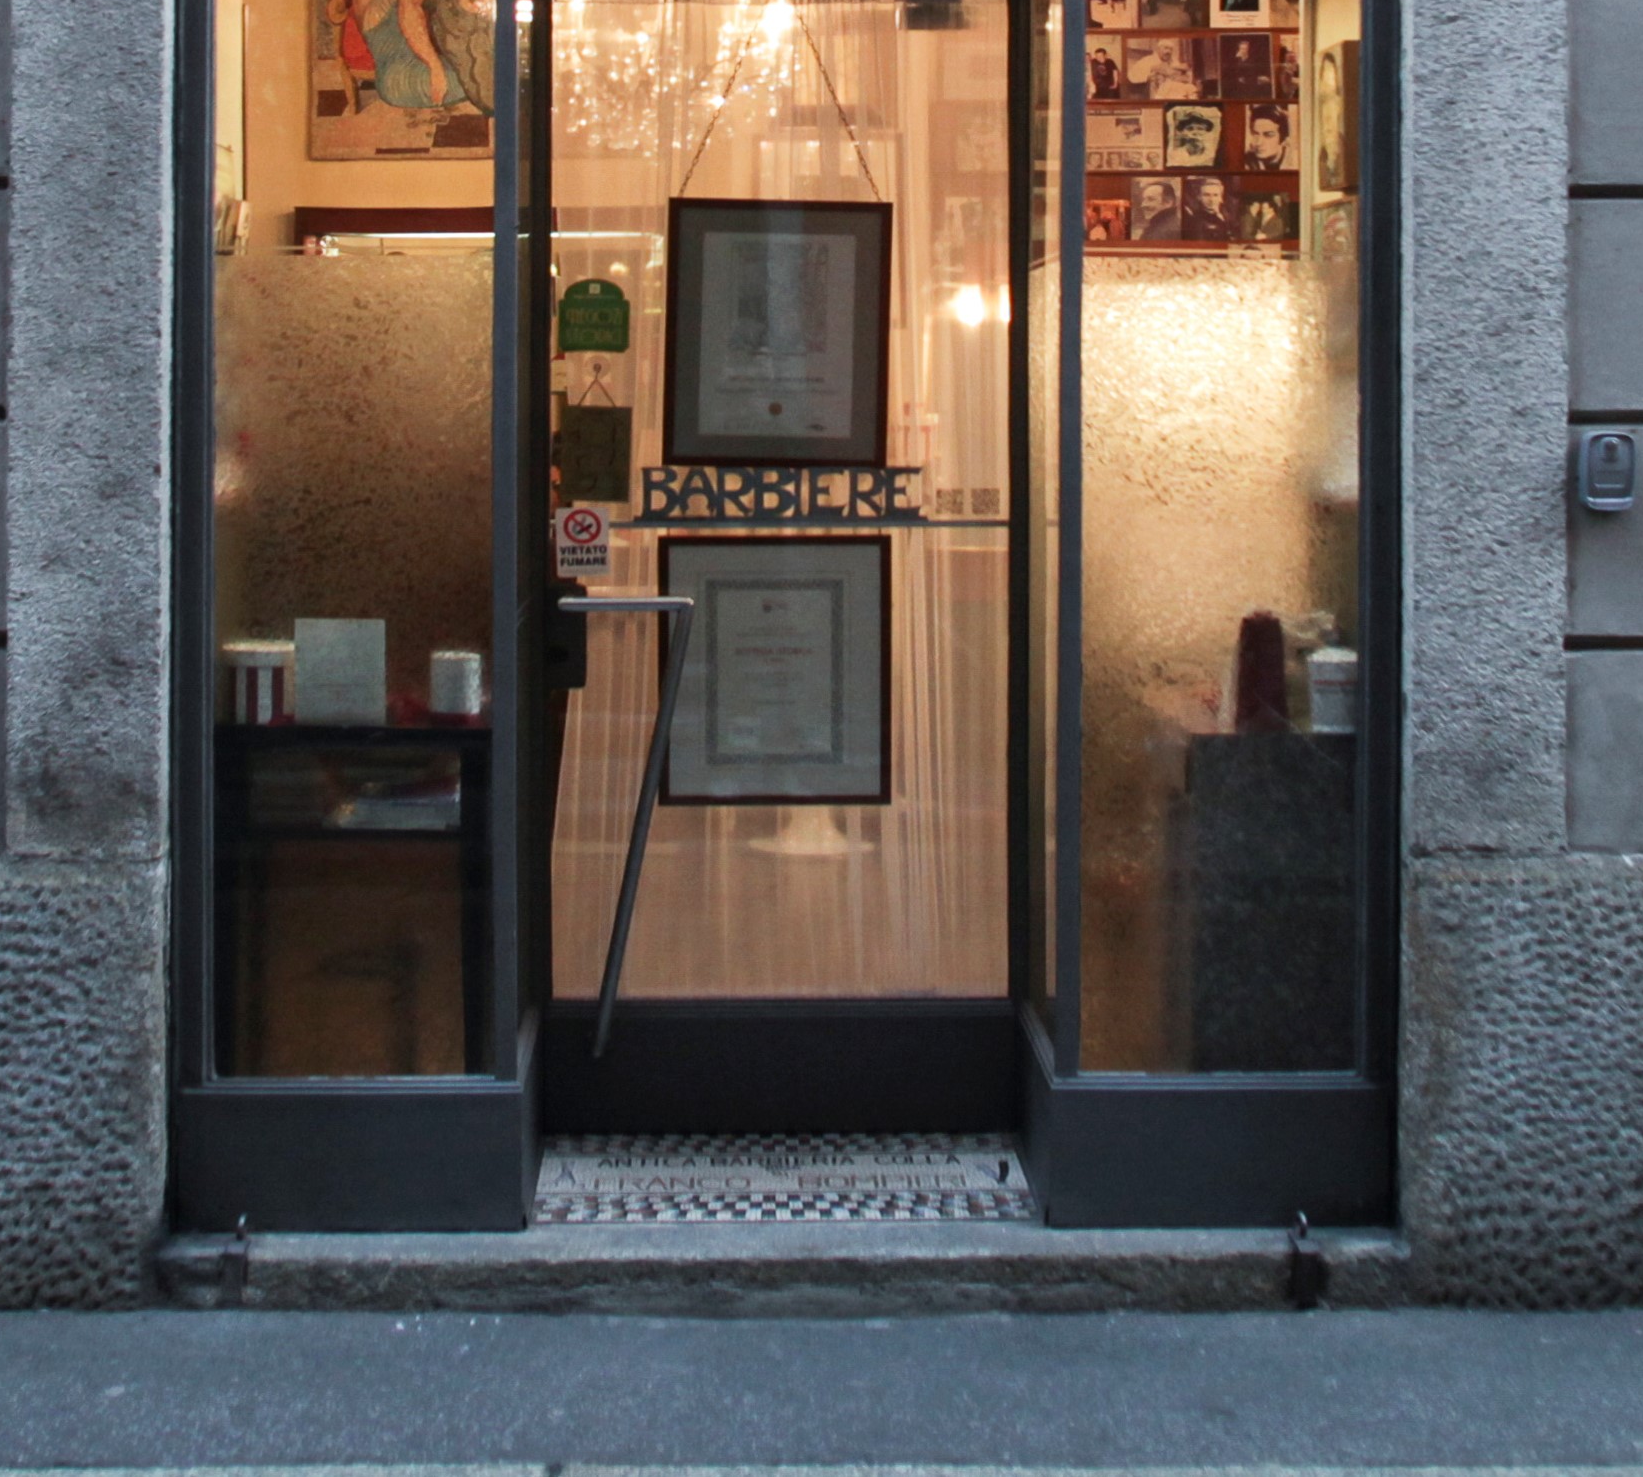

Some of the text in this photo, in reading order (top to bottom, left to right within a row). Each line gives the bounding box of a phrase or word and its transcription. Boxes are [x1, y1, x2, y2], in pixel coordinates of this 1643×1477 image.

[640, 466, 923, 519] BARBIERE
[560, 544, 607, 555] VIETATO
[560, 556, 607, 567] FUMARE
